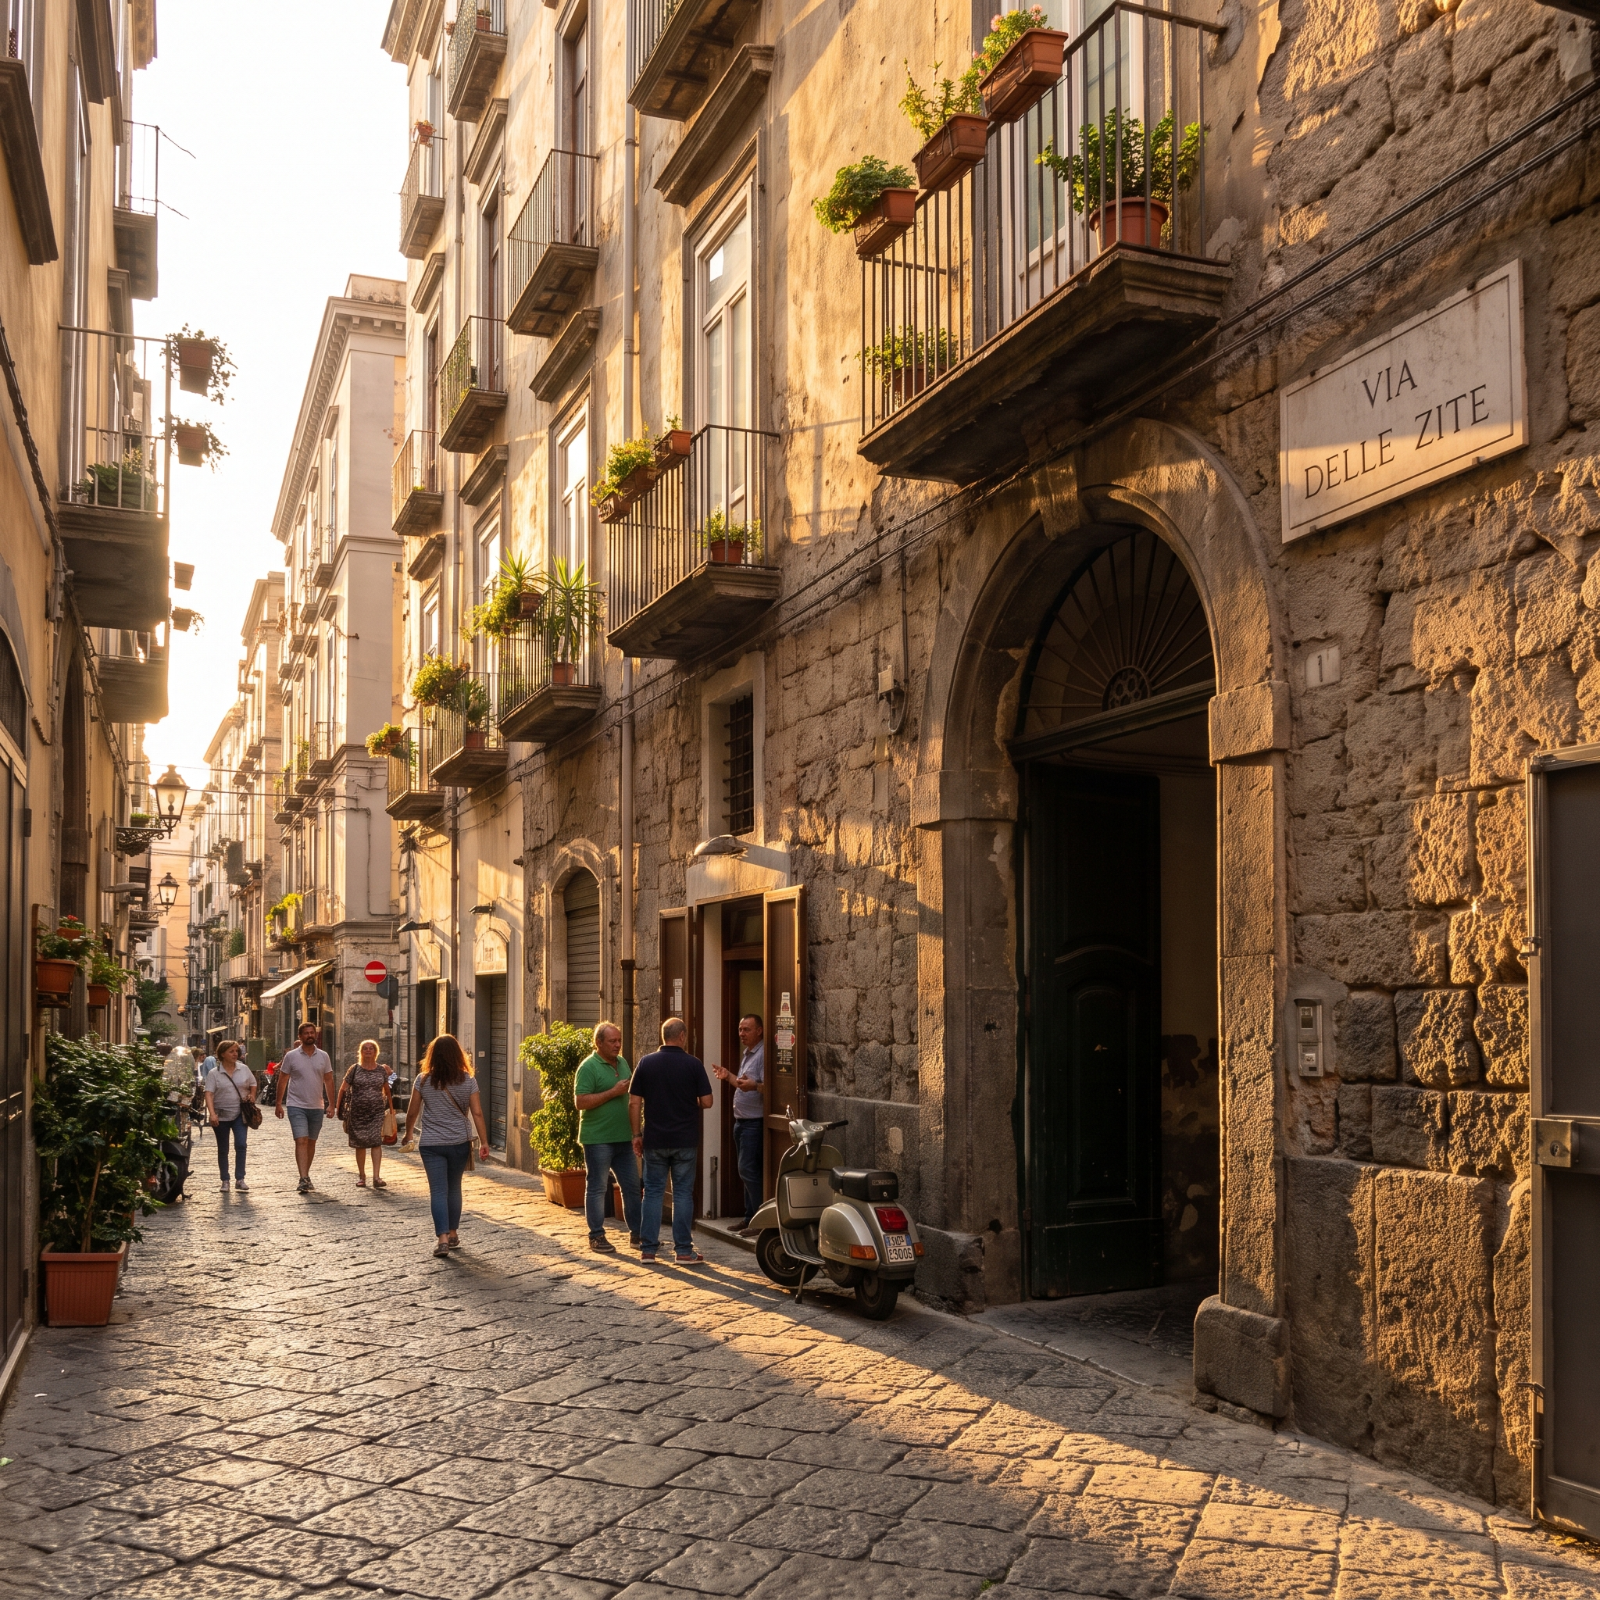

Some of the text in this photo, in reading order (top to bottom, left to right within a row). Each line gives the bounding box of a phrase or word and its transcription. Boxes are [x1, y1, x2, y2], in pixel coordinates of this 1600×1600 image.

[1361, 359, 1418, 409] VIA
[1304, 383, 1490, 500] DELLE ZITE
